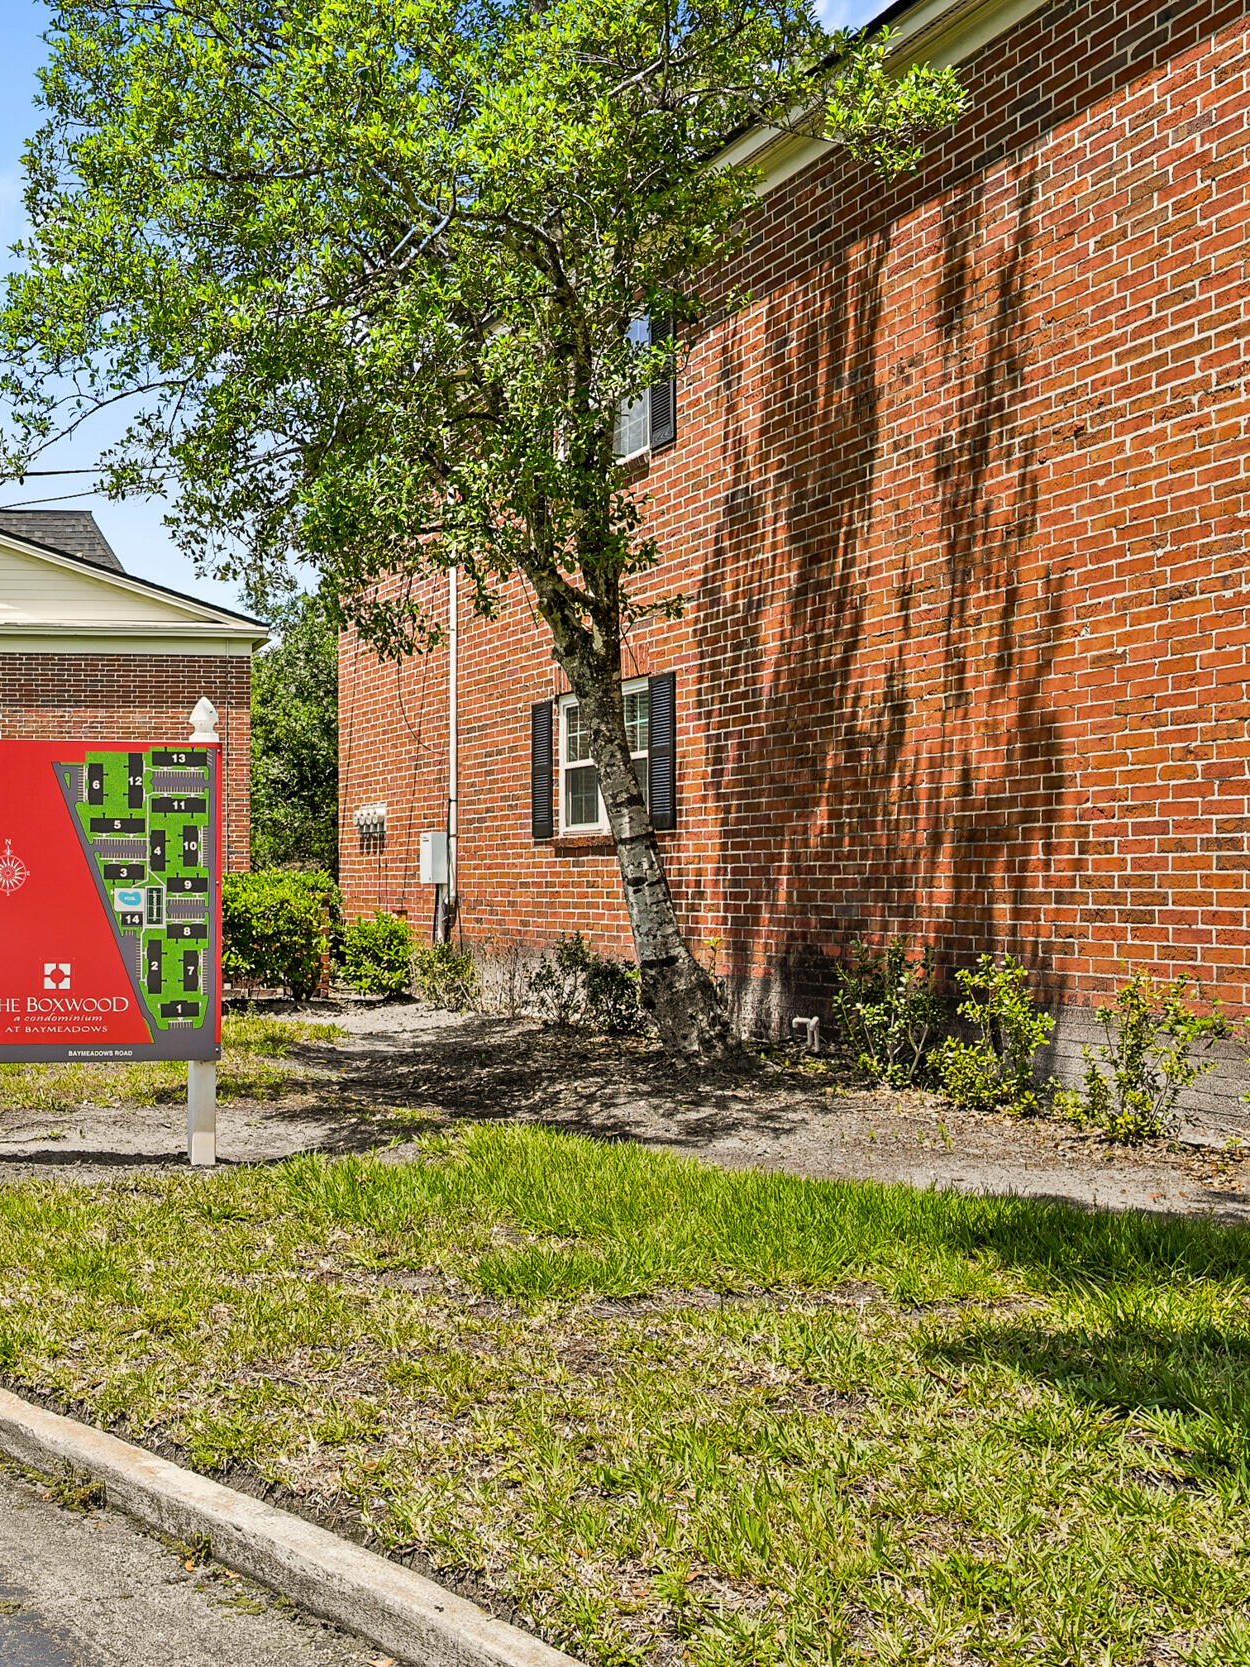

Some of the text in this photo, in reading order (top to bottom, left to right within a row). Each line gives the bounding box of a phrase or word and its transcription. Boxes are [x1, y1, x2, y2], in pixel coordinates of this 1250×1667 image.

[172, 754, 185, 762] 13
[93, 780, 100, 789] 6
[128, 777, 142, 785] 12
[173, 801, 184, 809] 11
[114, 820, 121, 829] 5
[184, 841, 197, 850] 10
[154, 847, 161, 855] 4
[120, 868, 127, 877] 3
[184, 881, 192, 889] 9
[126, 915, 139, 923] 14
[183, 927, 191, 936] 8
[151, 961, 158, 970] 2
[187, 967, 194, 975] 7
[27, 997, 129, 1012] BOXWOOD
[176, 1005, 182, 1013] 1
[25, 1025, 108, 1033] BAYMEADOWS
